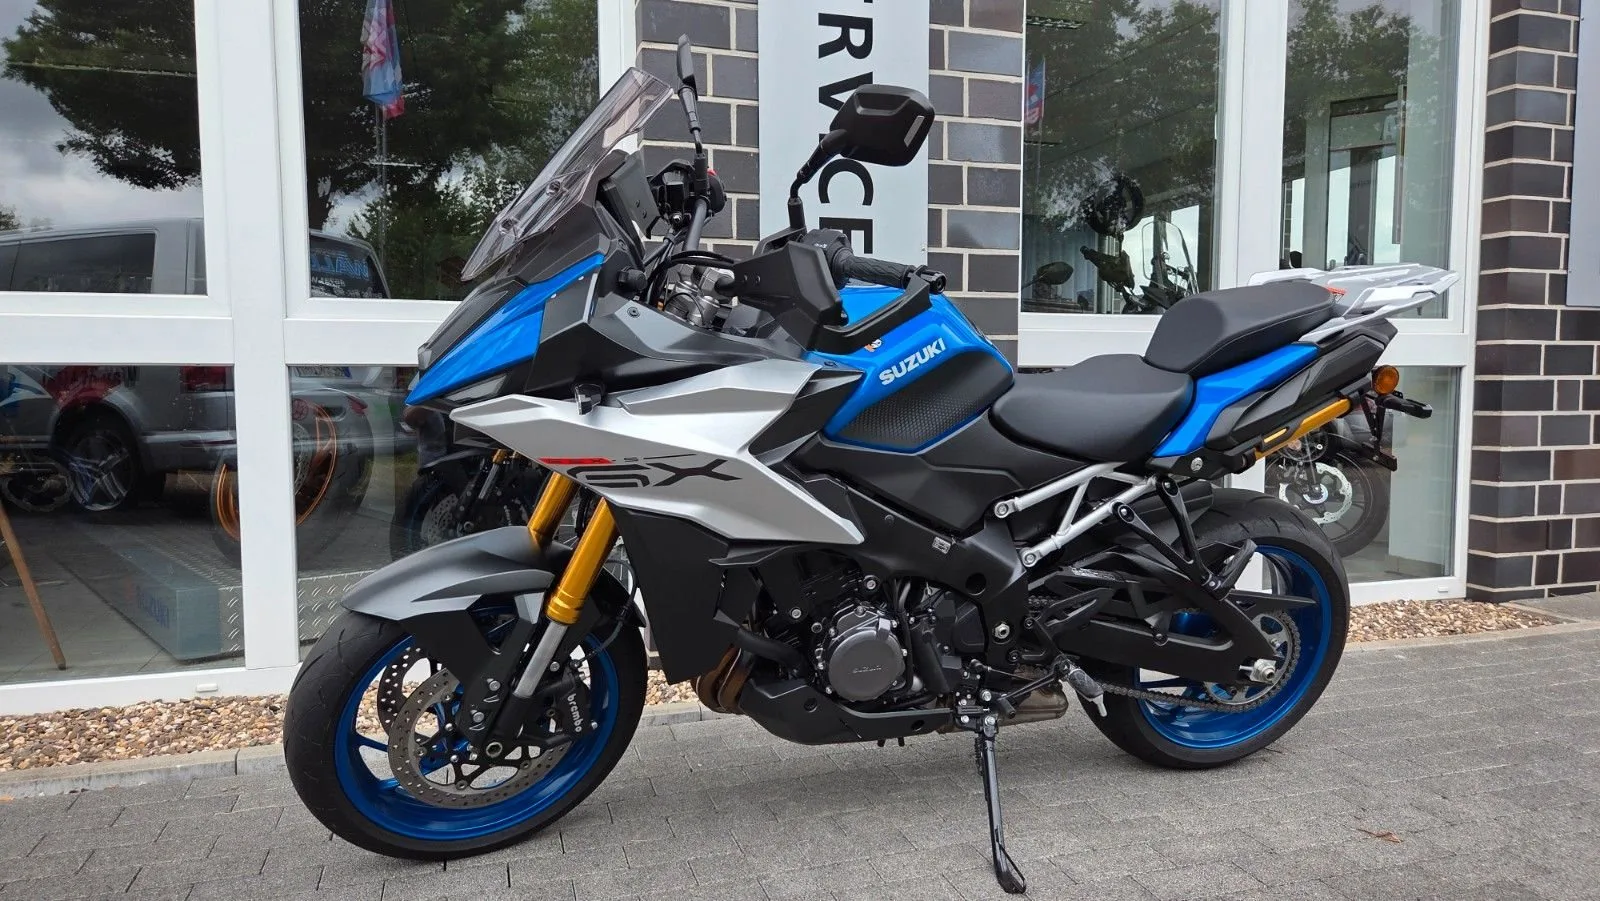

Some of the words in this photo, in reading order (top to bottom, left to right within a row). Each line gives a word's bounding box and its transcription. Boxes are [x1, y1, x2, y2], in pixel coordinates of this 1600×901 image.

[817, 0, 874, 254] RVCE
[879, 337, 946, 386] SUZUKI
[567, 458, 743, 488] GX
[567, 693, 583, 733] brembo
